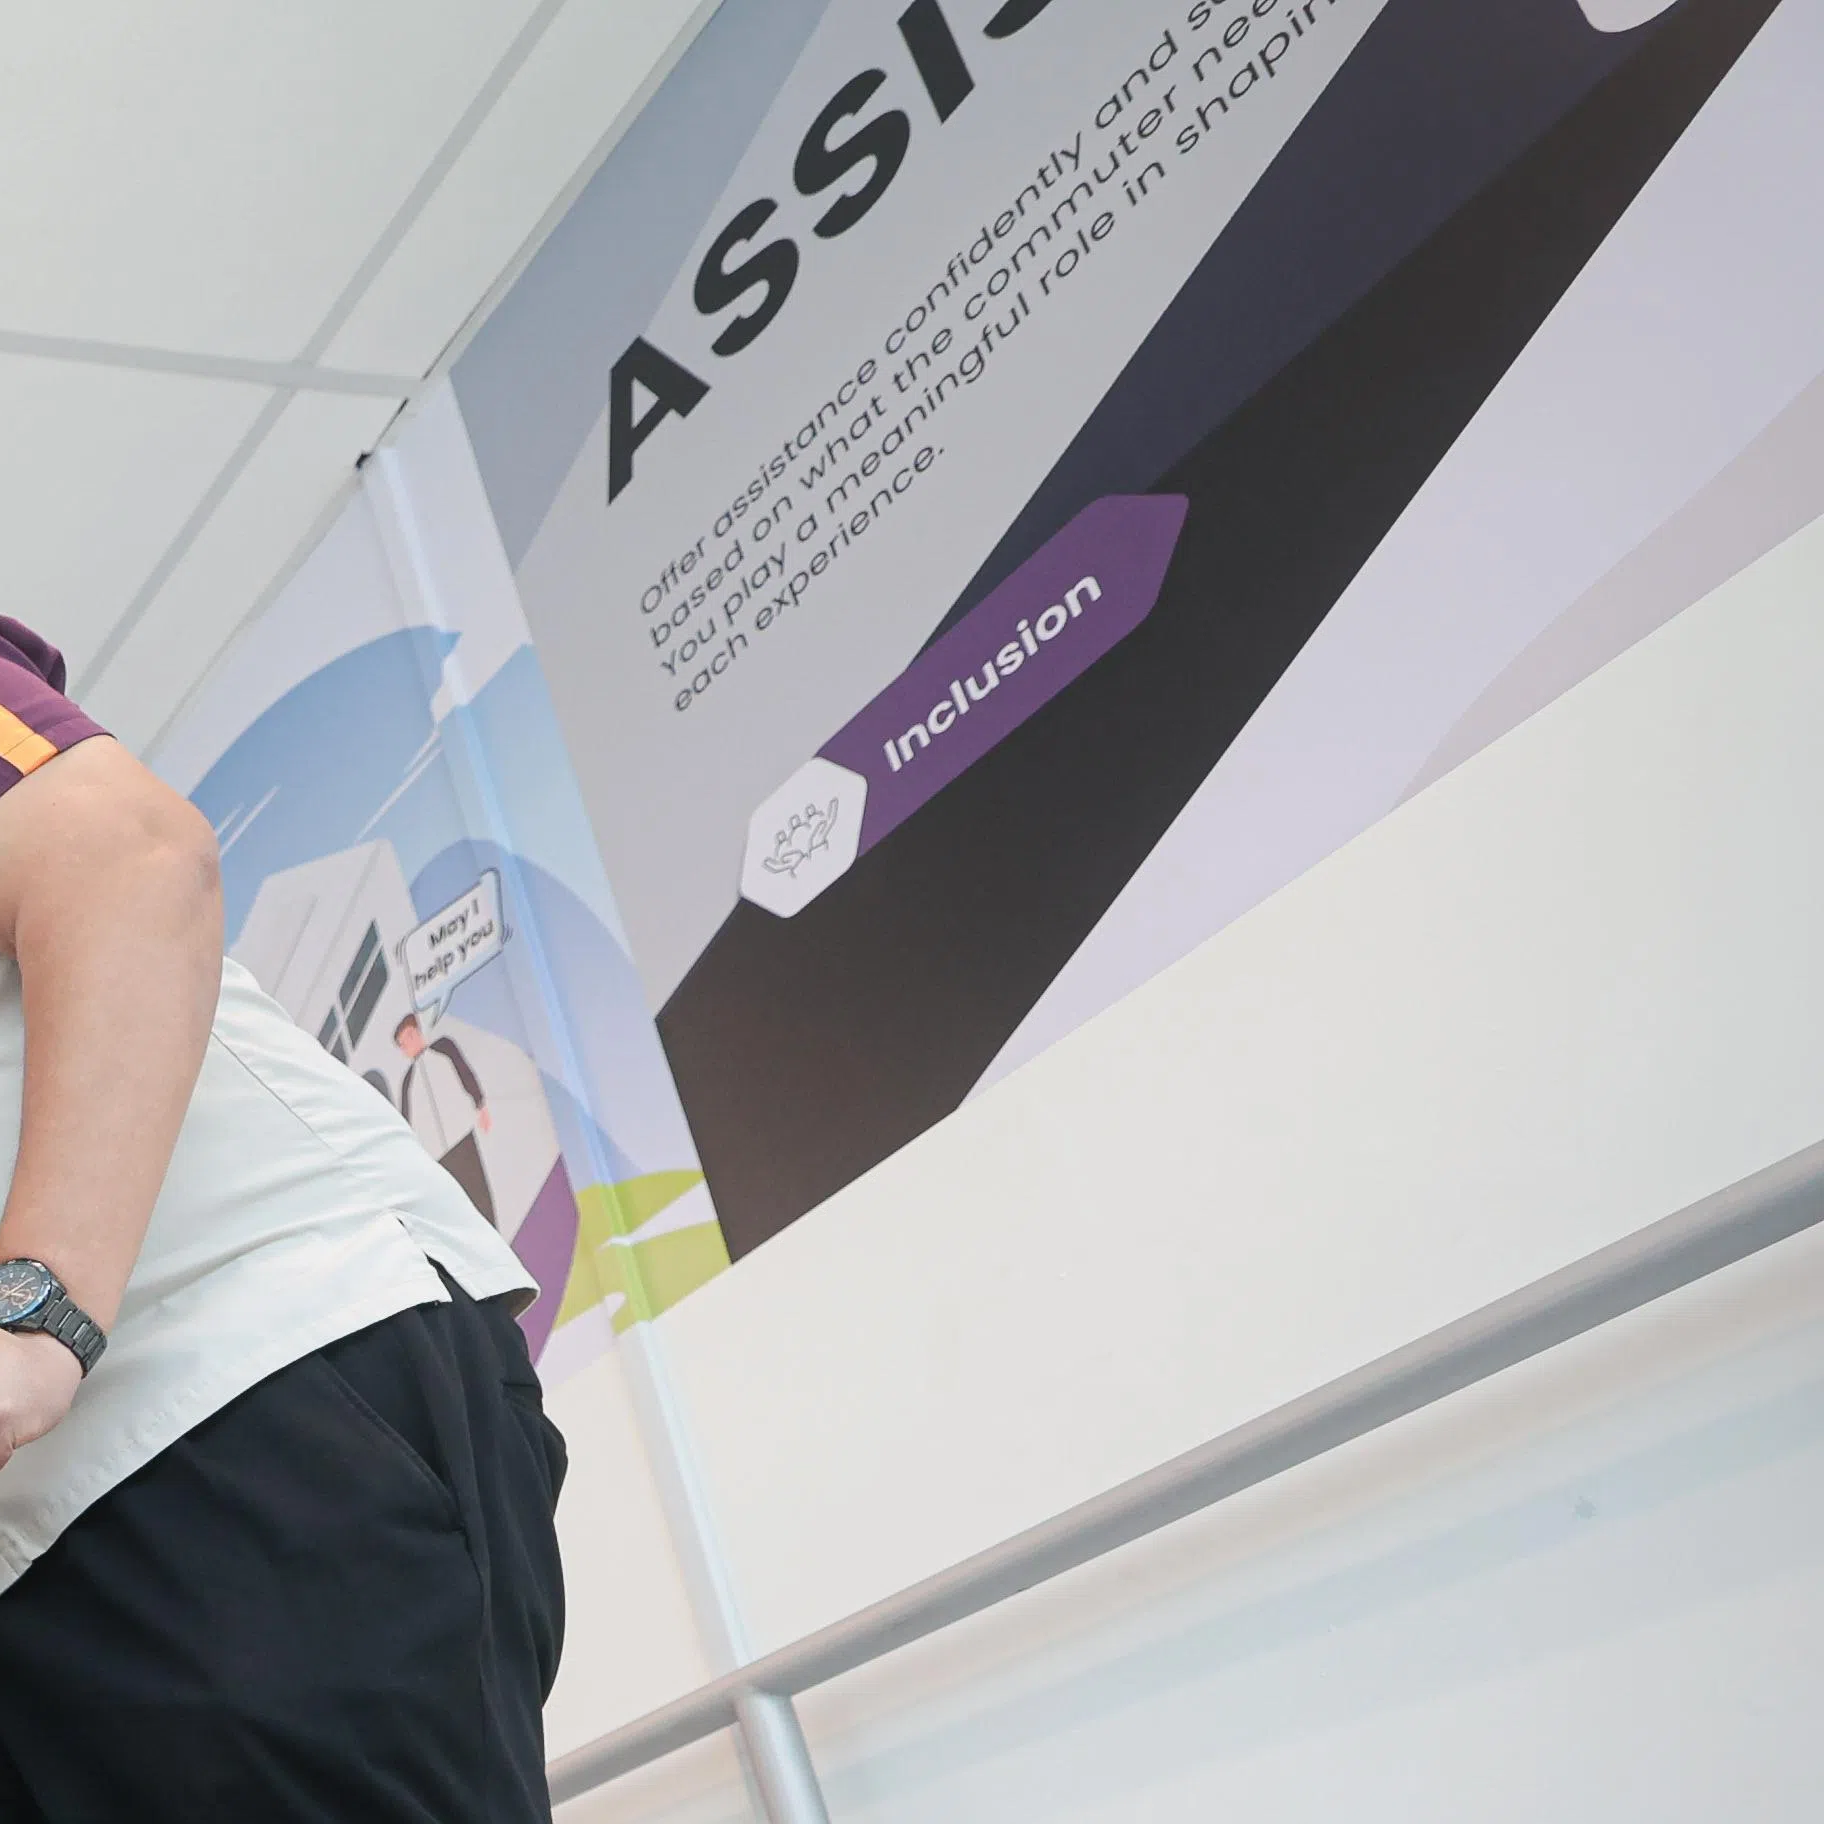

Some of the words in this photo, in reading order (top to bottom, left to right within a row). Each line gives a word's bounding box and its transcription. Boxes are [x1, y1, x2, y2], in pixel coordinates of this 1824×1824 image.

[640, 536, 705, 615] Offer
[712, 358, 878, 539] assistance
[884, 130, 1082, 356] confidently
[1094, 28, 1179, 130] and
[649, 538, 745, 649] based
[751, 495, 793, 543] on
[798, 395, 887, 491] what
[891, 327, 953, 394] the
[963, 84, 1177, 321] commuter
[1191, 0, 1279, 83] nee
[660, 617, 717, 676] You
[722, 541, 786, 627] play
[796, 512, 819, 544] a
[826, 291, 1031, 515] meaningful
[1038, 211, 1116, 297] role
[1121, 161, 1166, 207] in
[1175, 0, 1336, 155] shapin
[674, 632, 749, 713] each
[754, 445, 945, 632] experience.
[882, 575, 1103, 772] Inclusion
[414, 952, 455, 990] help
[456, 919, 494, 963] you
[429, 910, 469, 949] May
[472, 898, 479, 915] I
